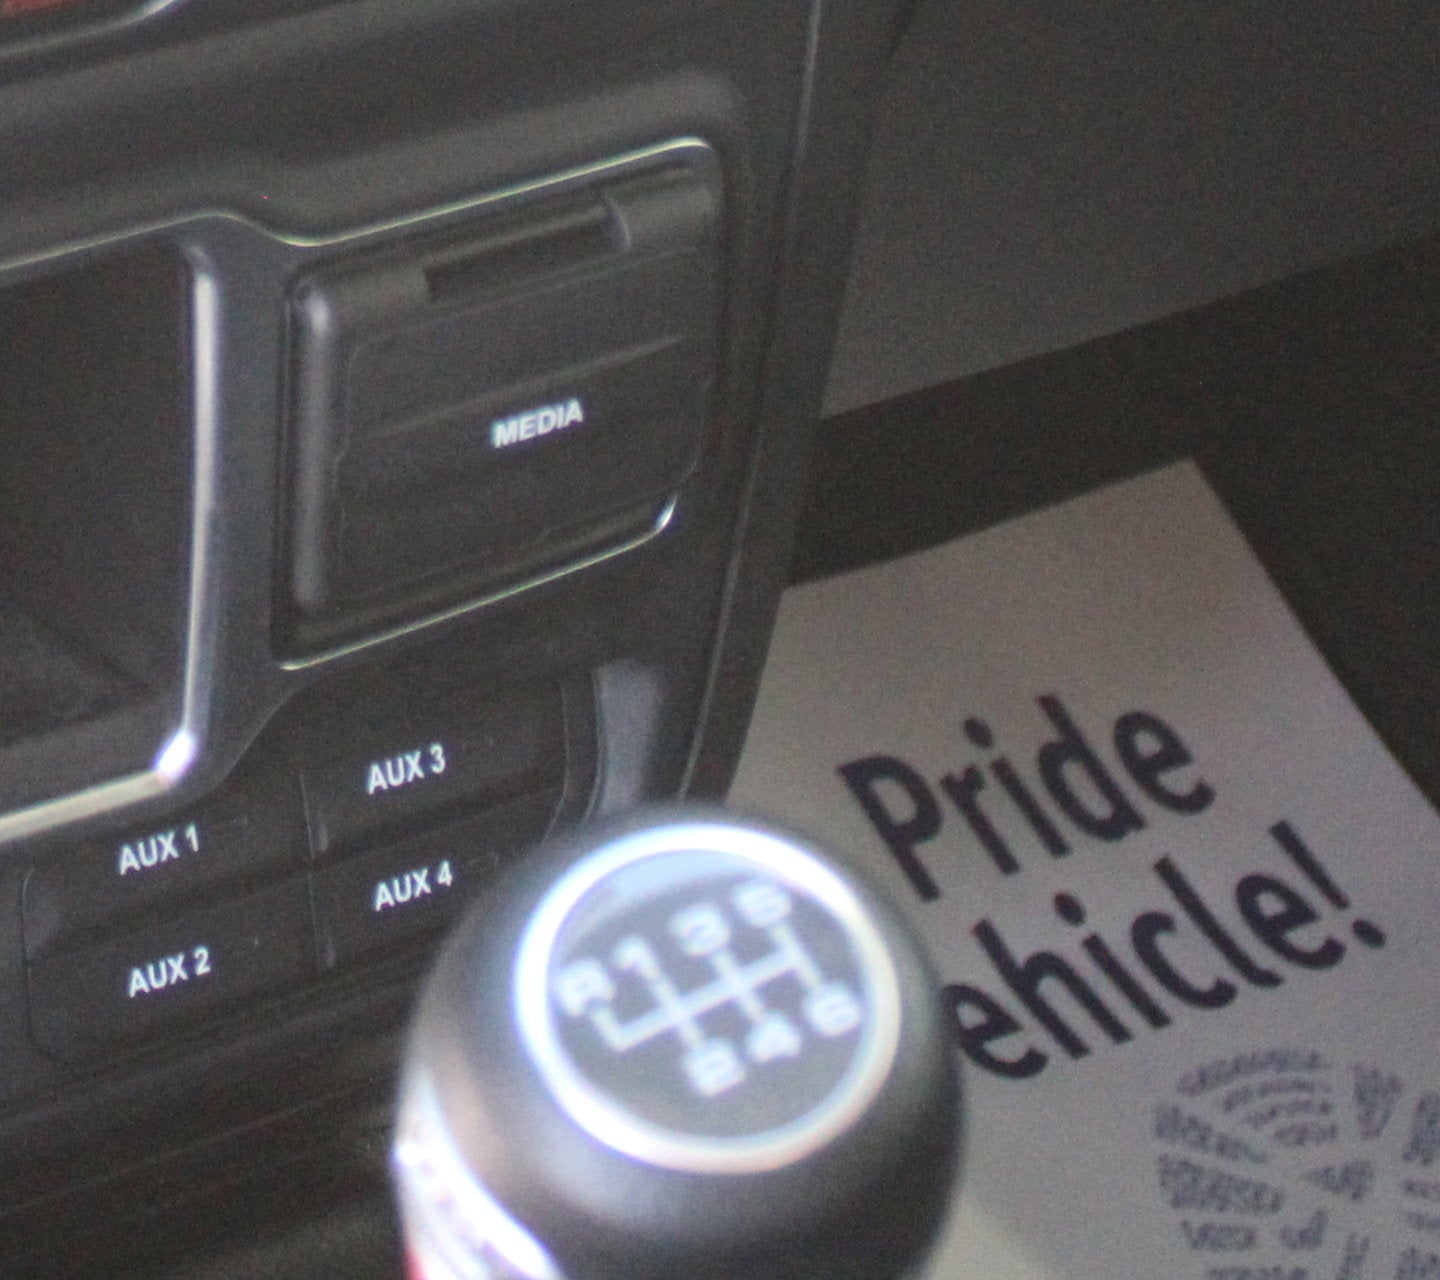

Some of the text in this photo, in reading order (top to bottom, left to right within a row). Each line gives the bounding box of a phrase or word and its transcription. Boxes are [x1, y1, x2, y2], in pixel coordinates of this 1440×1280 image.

[490, 398, 585, 449] MEDIA
[366, 742, 446, 795] AUX 3
[836, 693, 1216, 903] Pride
[118, 821, 200, 875] AUX 1
[373, 858, 454, 912] AUX 4
[128, 944, 212, 998] AUX 2
[940, 819, 1386, 1080] ehicle!
